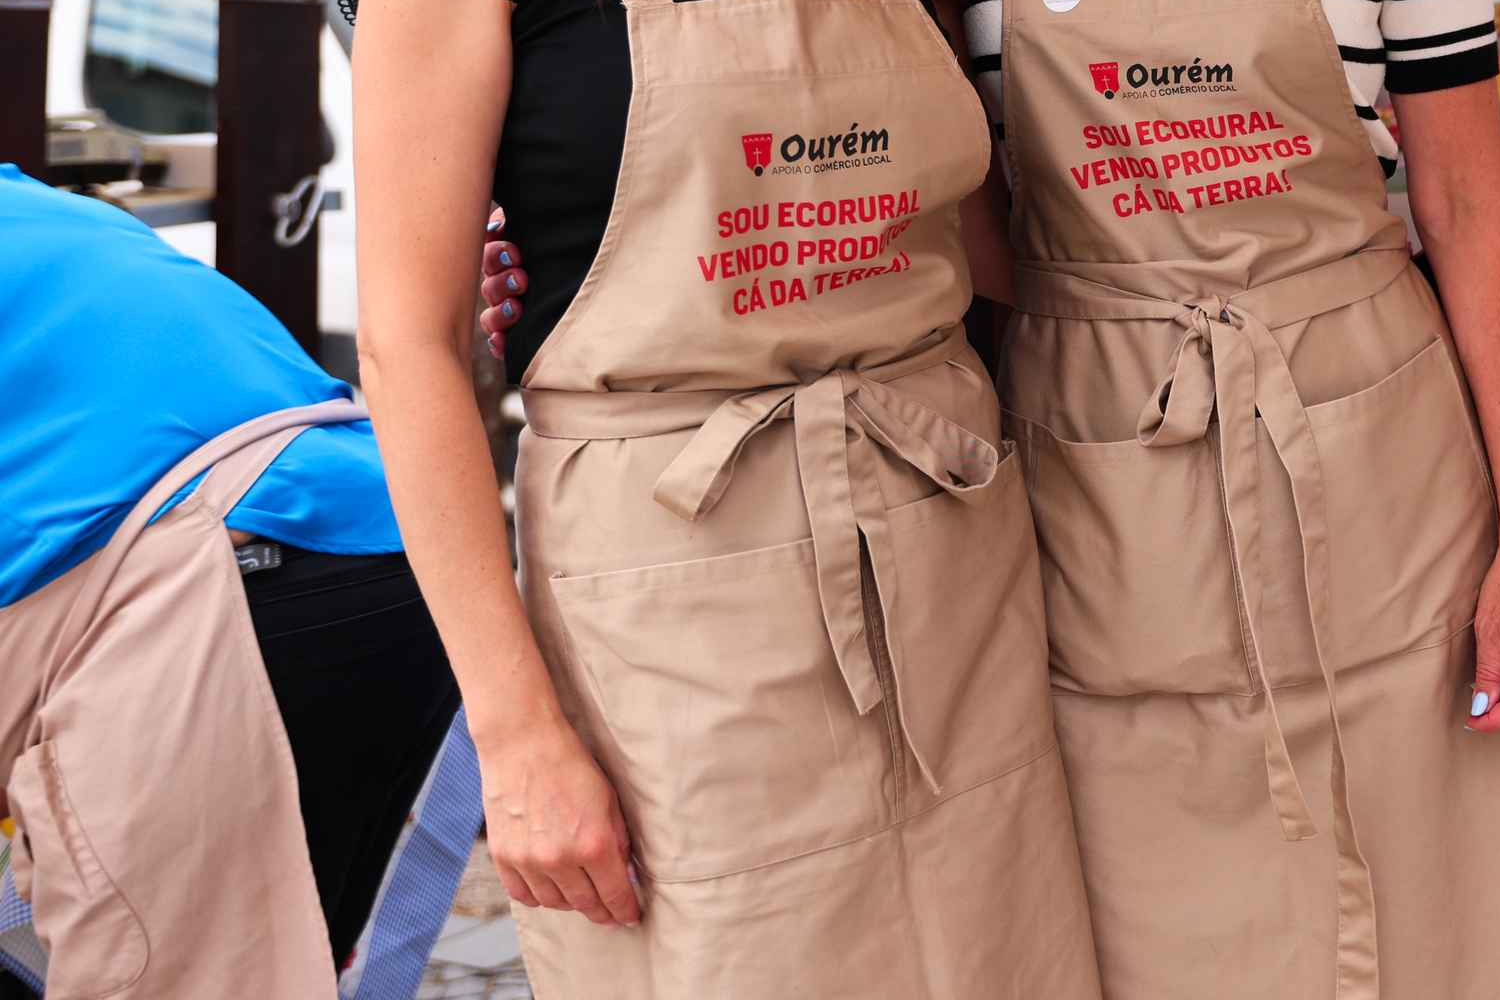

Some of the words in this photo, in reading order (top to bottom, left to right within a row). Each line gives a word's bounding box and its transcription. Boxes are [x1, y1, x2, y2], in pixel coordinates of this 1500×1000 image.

[1122, 90, 1148, 100] APOIA
[1150, 89, 1157, 98] O
[1158, 85, 1207, 97] COMÉRCIO
[1208, 84, 1237, 93] LOCAL
[1126, 57, 1234, 89] Ourém
[779, 122, 890, 164] Ourém
[1082, 123, 1131, 150] SOU
[1135, 111, 1284, 145] ECORURAL
[771, 166, 802, 176] APOIA
[804, 165, 812, 175] O
[813, 158, 861, 173] COMÉRCIO
[862, 154, 891, 167] LOCAL
[1070, 156, 1159, 191] VENDO
[1161, 134, 1313, 179] PRODUTOS
[1112, 184, 1152, 218] CÁ
[1156, 188, 1186, 215] DA
[1187, 169, 1293, 209] TERRA!
[717, 203, 769, 239] SOU
[777, 189, 921, 228] ECORURAL
[697, 240, 789, 282] VENDO
[732, 277, 767, 316] CÁ
[769, 277, 808, 308] DA
